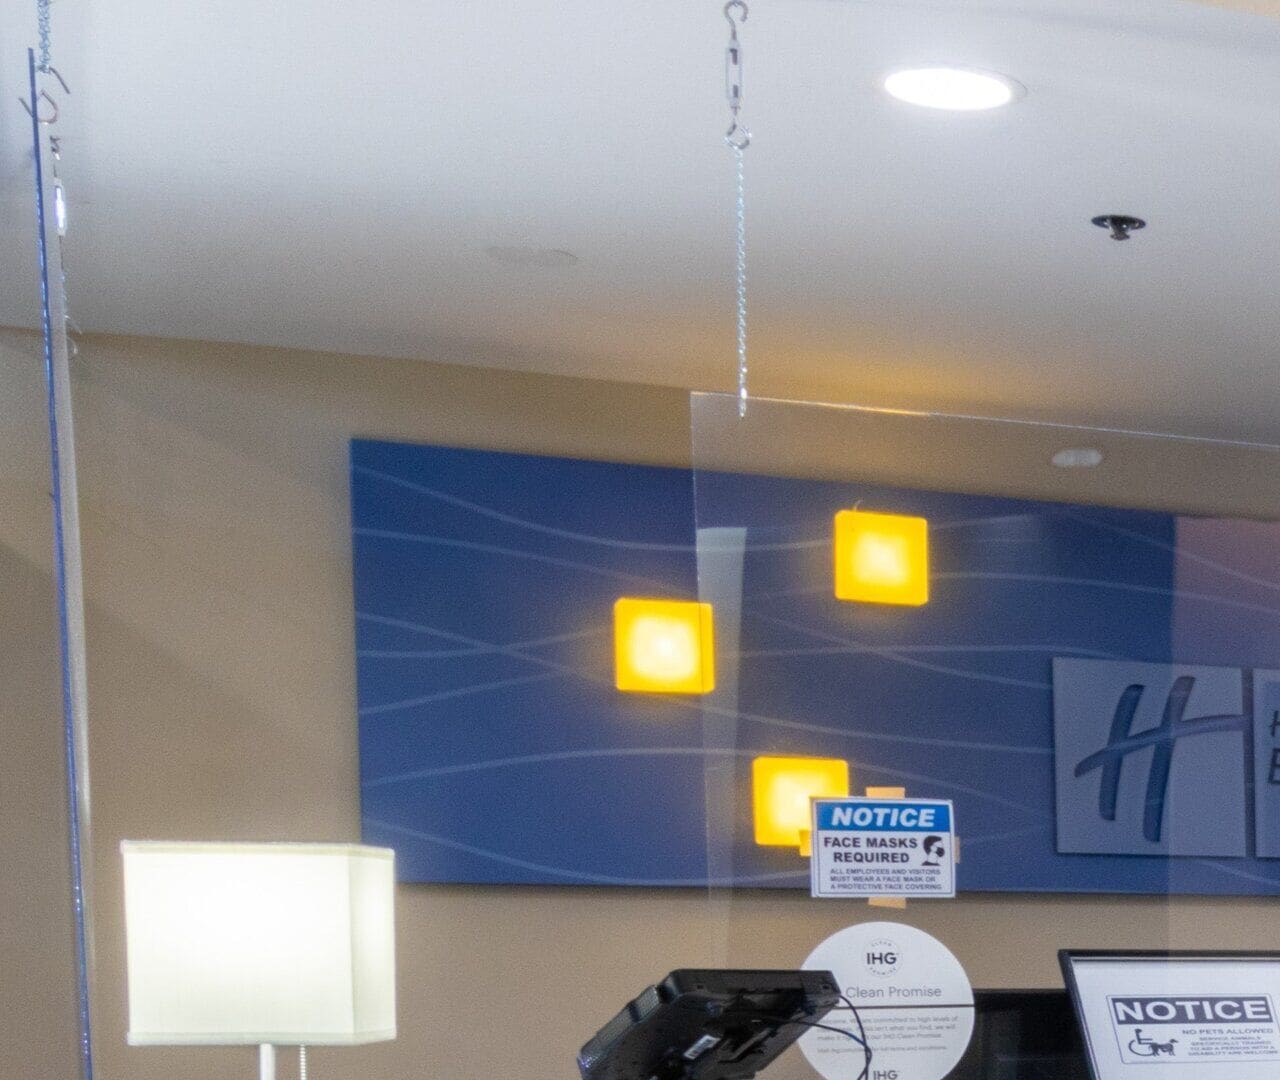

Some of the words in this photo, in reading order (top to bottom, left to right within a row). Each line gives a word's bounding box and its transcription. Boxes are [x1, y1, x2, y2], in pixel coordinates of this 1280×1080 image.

[831, 807, 936, 828] NOTICE
[824, 837, 861, 848] FACE
[866, 837, 918, 849] MASKS
[833, 852, 910, 863] REQUIRED
[866, 952, 897, 965] IHG
[845, 986, 884, 998] Clean
[888, 986, 942, 998] Promise
[1115, 1000, 1270, 1021] NOTICE
[873, 1070, 898, 1080] IHG
